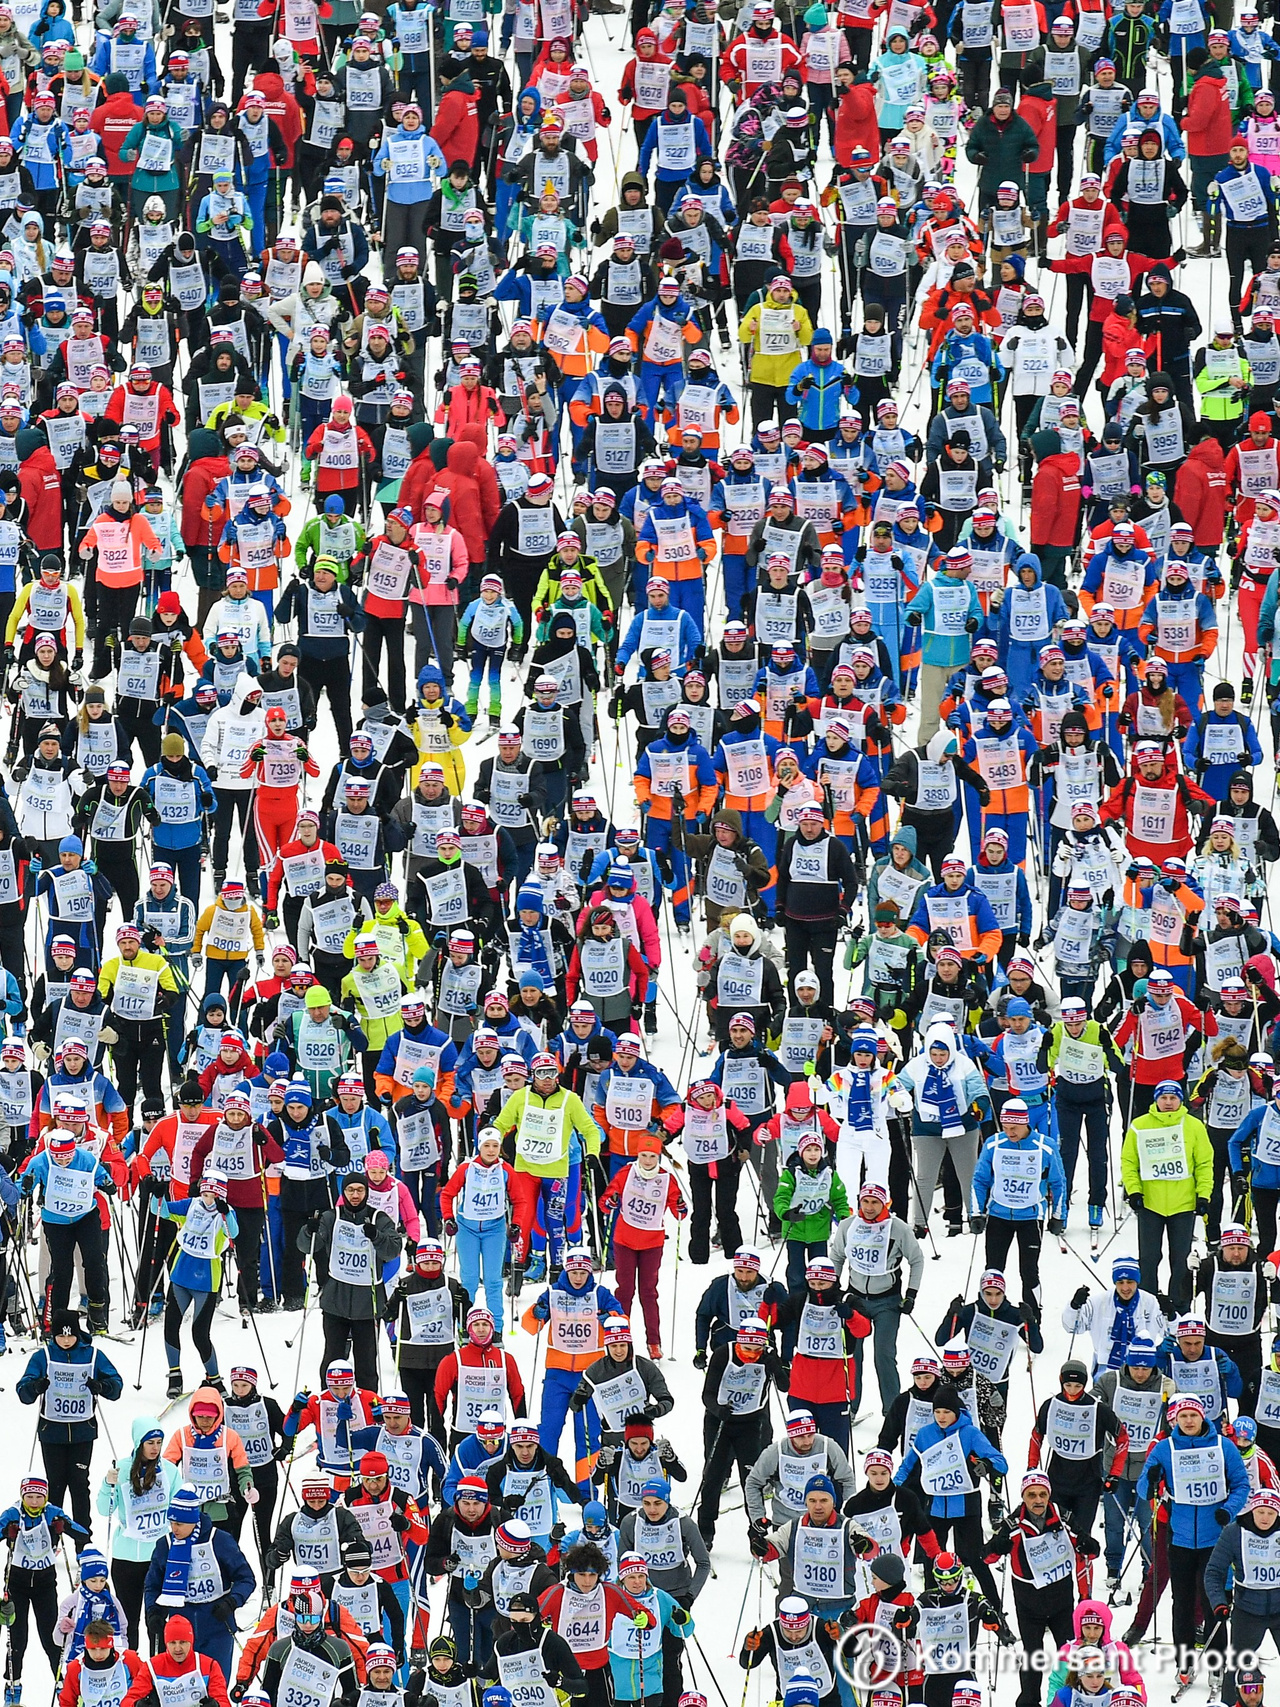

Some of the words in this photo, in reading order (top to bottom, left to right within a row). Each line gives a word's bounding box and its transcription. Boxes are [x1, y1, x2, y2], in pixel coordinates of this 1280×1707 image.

[180, 289, 202, 299] 6407
[459, 330, 482, 341] 9743
[765, 334, 789, 345] 7270
[141, 346, 162, 356] 4161
[860, 357, 883, 369] 7310
[1023, 360, 1048, 371] 5224
[958, 367, 981, 376] 7026
[1153, 434, 1177, 448] 3952
[326, 454, 351, 466] 4008
[605, 449, 631, 462] 5127
[1247, 476, 1272, 489] 6481
[804, 507, 830, 520] 5266
[247, 546, 272, 558] 5425
[664, 546, 690, 559] 5303
[372, 572, 397, 587] 4153
[869, 577, 896, 589] 3255
[1108, 582, 1133, 596] 5301
[766, 621, 792, 633] 5327
[1015, 615, 1041, 627] 6739
[1163, 627, 1189, 639] 5381
[127, 678, 145, 690] 674
[530, 737, 557, 750] 1690
[1210, 751, 1236, 764] 6709
[270, 763, 295, 775] 7339
[738, 768, 762, 782] 5108
[988, 764, 1016, 778] 5483
[924, 788, 950, 801] 3880
[1066, 782, 1092, 795] 3647
[161, 806, 188, 818] 4323
[495, 802, 520, 815] 3223
[1141, 816, 1165, 829] 1611
[341, 843, 368, 856] 3484
[796, 857, 820, 871] 6363
[712, 876, 737, 894] 3010
[1061, 938, 1080, 953] 754
[589, 970, 618, 983] 4020
[723, 983, 752, 996] 4046
[120, 996, 144, 1009] 1117
[1152, 1029, 1180, 1044] 7642
[306, 1044, 334, 1057] 5826
[614, 1108, 642, 1122] 5103
[1216, 1103, 1242, 1118] 7231
[521, 1140, 553, 1154] 3720
[695, 1139, 718, 1152] 784
[1152, 1161, 1183, 1178] 3498
[1004, 1179, 1032, 1194] 3547
[472, 1192, 498, 1207] 4471
[628, 1197, 657, 1215] 4351
[339, 1253, 367, 1267] 3708
[1217, 1304, 1248, 1320] 7100
[558, 1322, 591, 1338] 5466
[806, 1337, 836, 1351] 1873
[55, 1399, 85, 1414] 3608
[1235, 1421, 1253, 1431] DNB
[1055, 1437, 1086, 1453] 9971
[930, 1472, 964, 1491] 7236
[1186, 1481, 1217, 1498] 1510
[299, 1545, 329, 1560] 6751
[804, 1564, 837, 1582] 3180
[566, 1619, 600, 1638] 6644
[512, 1685, 545, 1702] 6940
